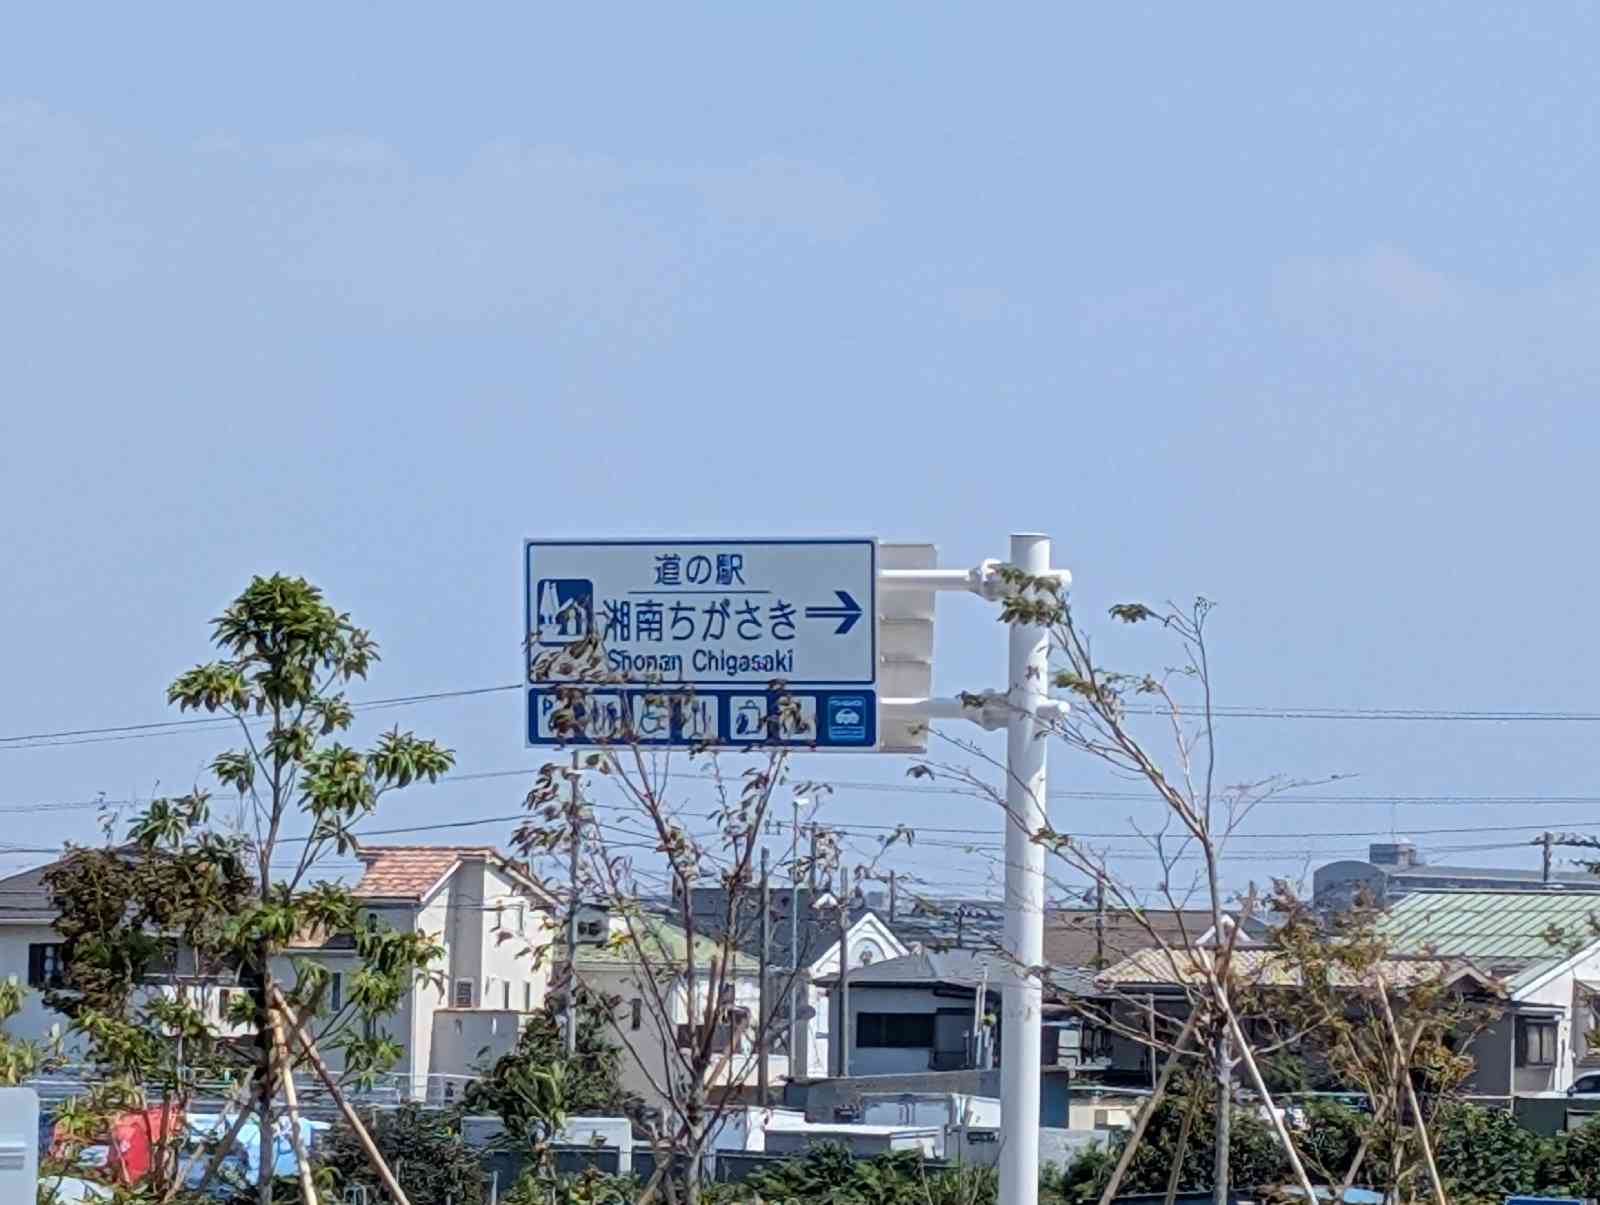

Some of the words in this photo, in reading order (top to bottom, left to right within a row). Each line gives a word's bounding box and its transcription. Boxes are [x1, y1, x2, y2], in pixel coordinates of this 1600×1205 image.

[654, 553, 745, 585] 道の駅
[602, 598, 797, 642] 湘南ちがさき
[607, 649, 682, 672] Shonan
[692, 649, 794, 676] Chigasaki
